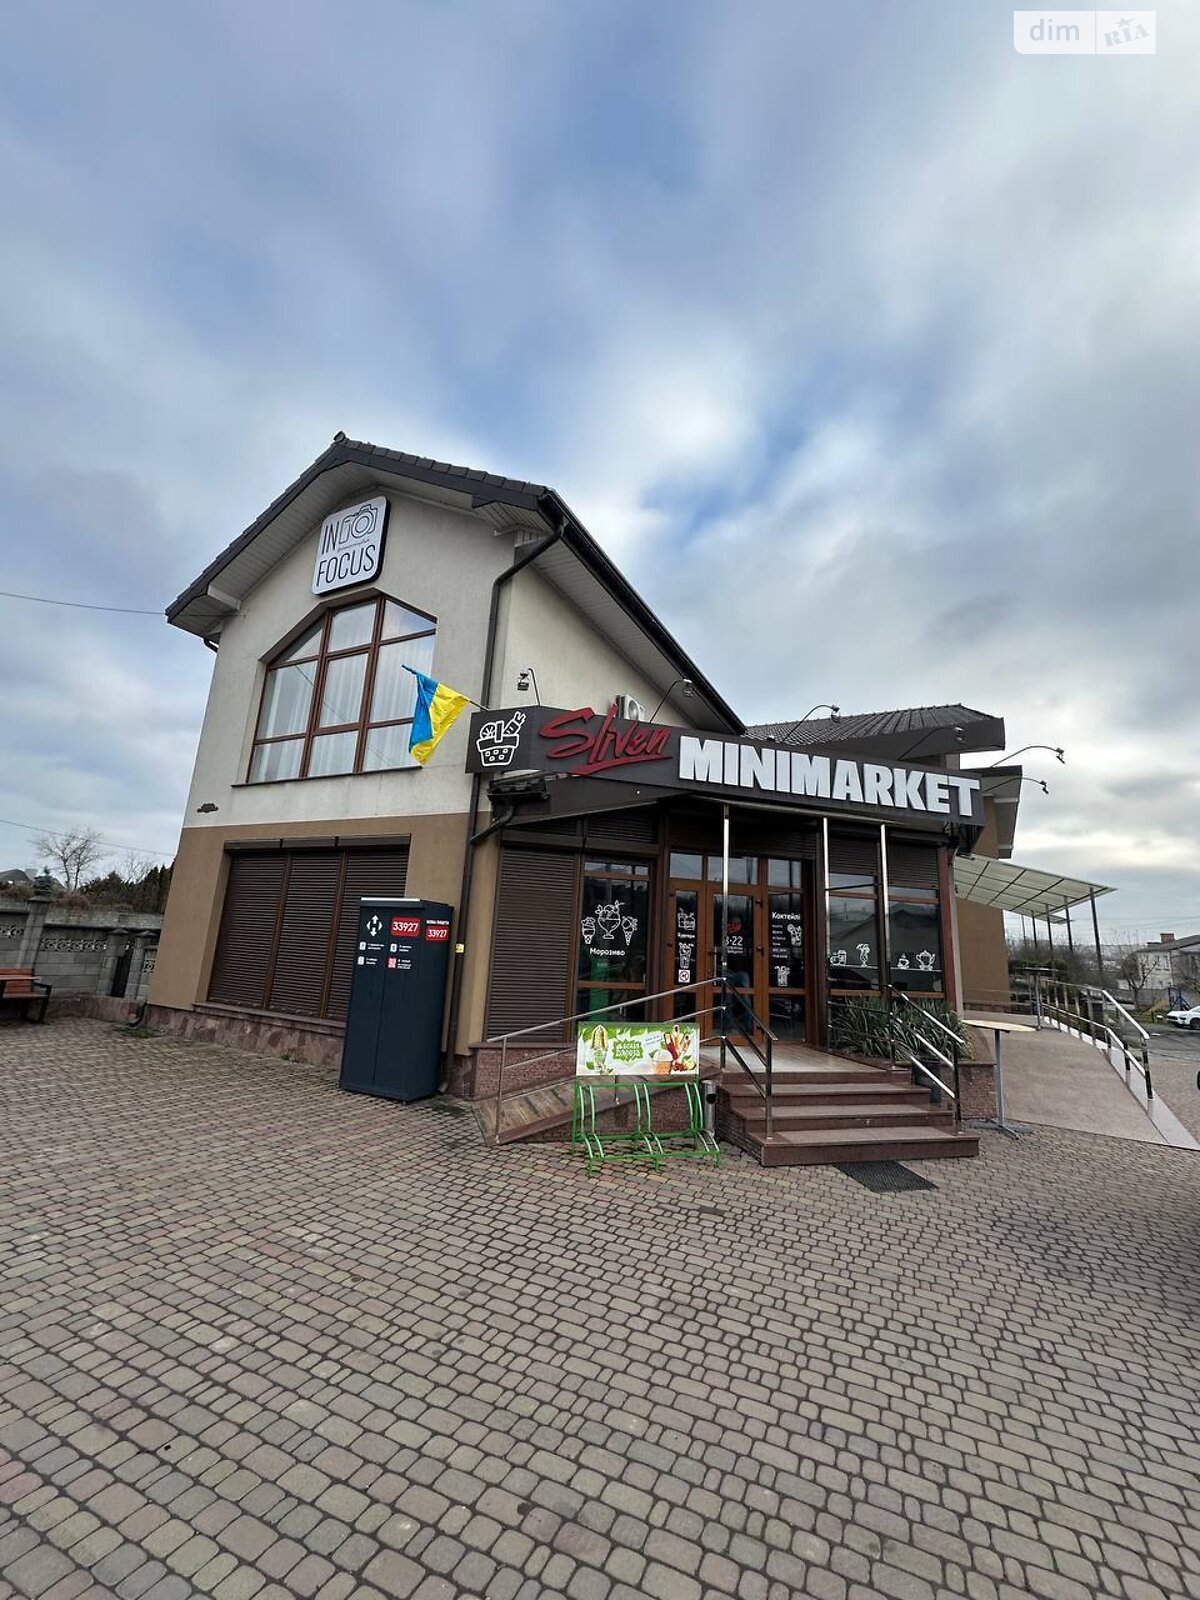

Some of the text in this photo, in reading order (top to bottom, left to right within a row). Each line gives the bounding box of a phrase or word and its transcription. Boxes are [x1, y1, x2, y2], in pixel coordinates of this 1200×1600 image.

[321, 520, 340, 555] IN
[316, 544, 376, 587] FOCUS
[678, 735, 981, 817] MINIMARKET
[392, 921, 419, 933] 33927
[589, 947, 626, 957] Морозиво
